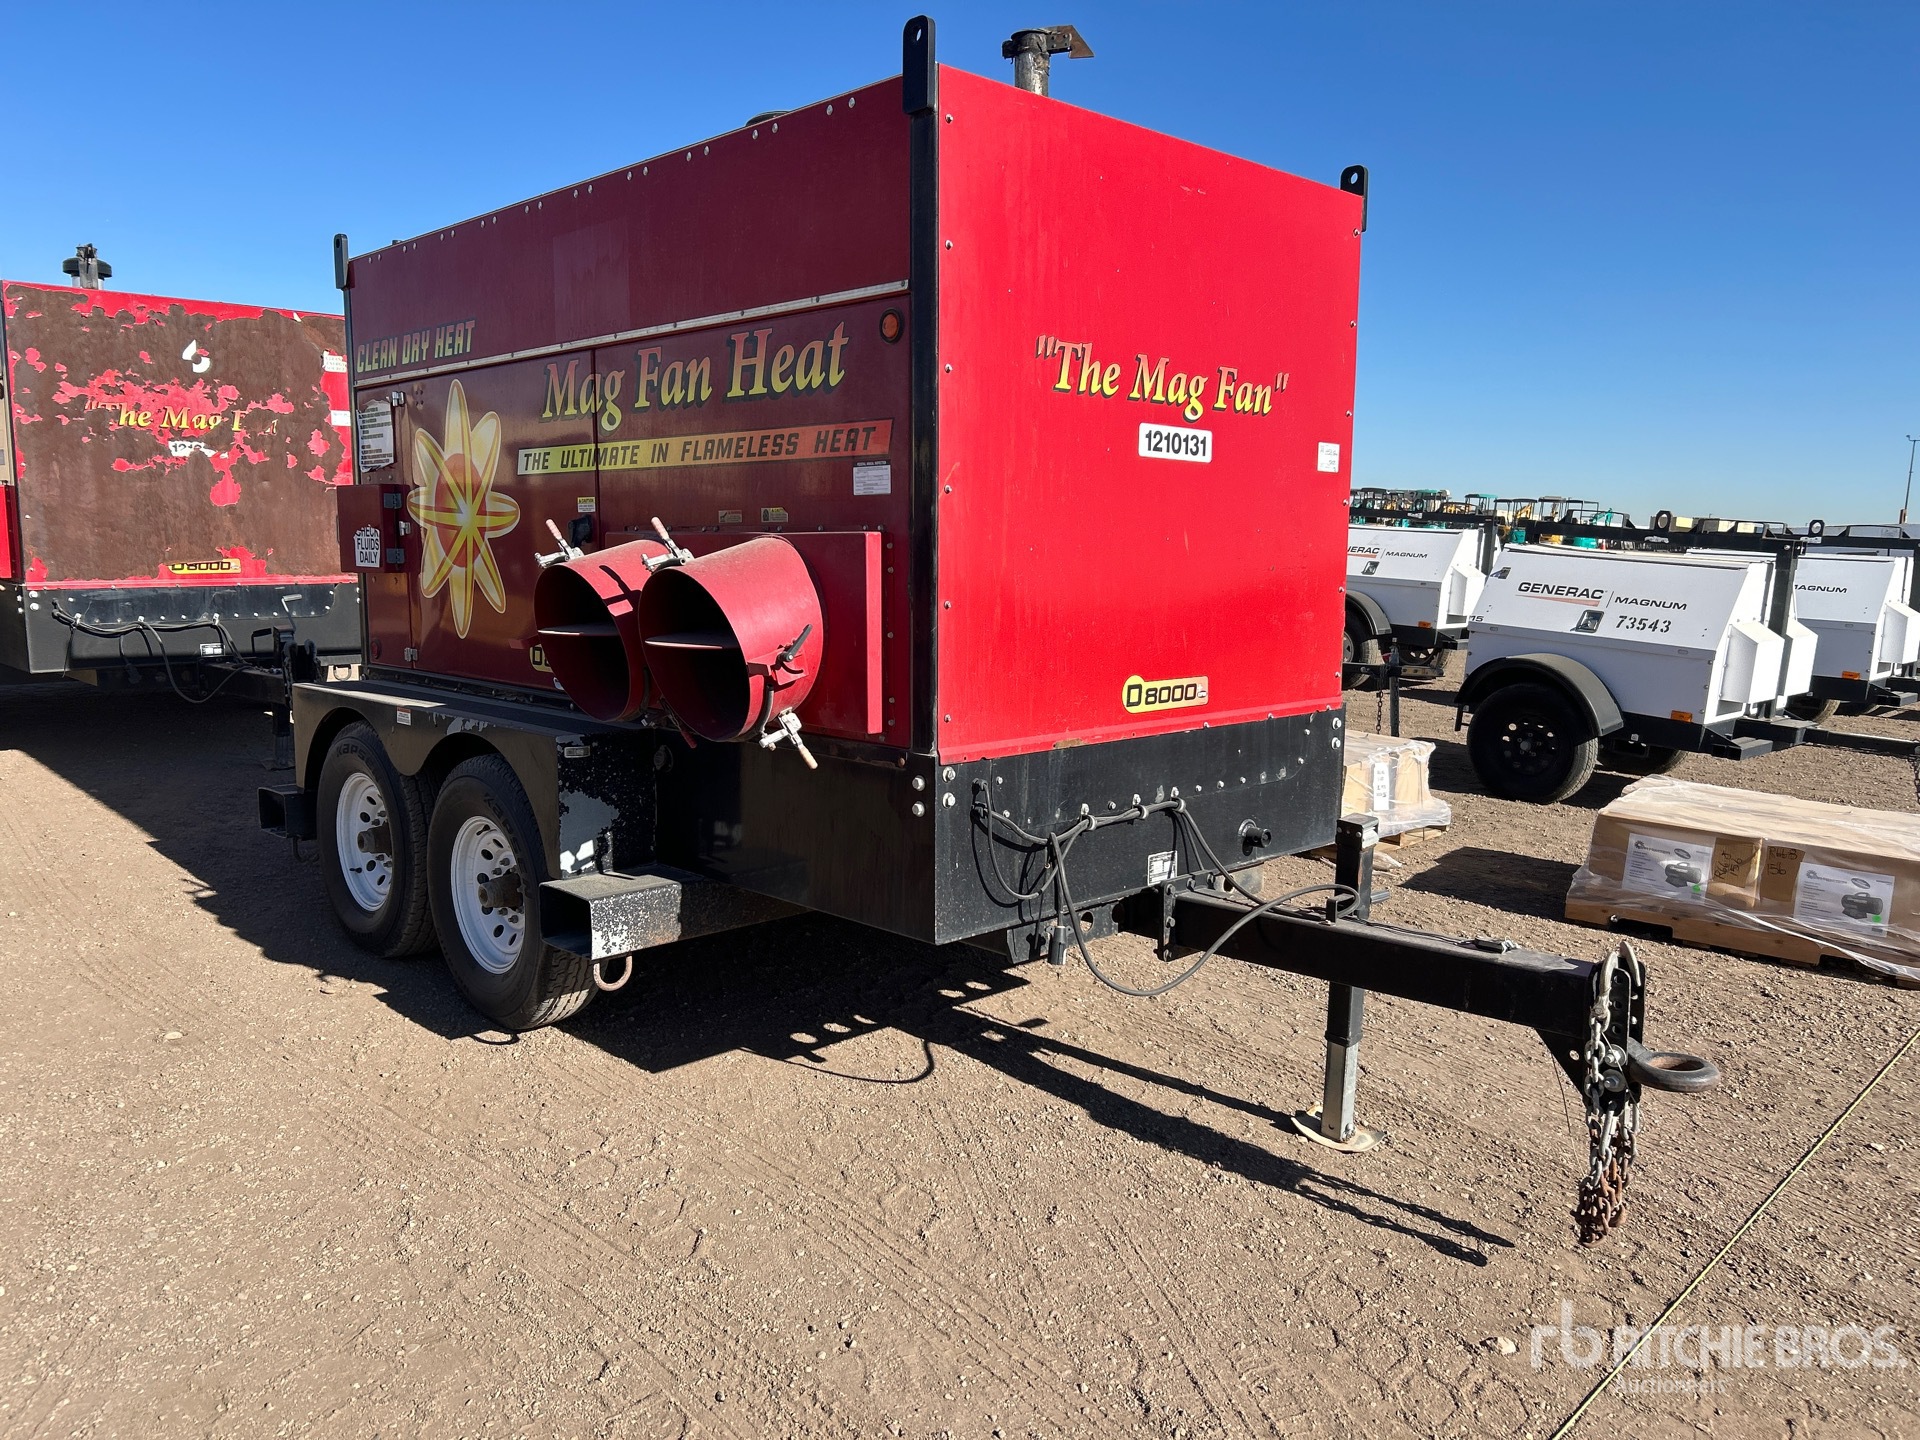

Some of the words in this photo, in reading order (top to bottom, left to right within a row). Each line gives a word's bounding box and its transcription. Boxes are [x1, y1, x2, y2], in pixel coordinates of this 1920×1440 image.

[356, 337, 398, 372] CLEAN
[402, 330, 430, 365] DRY
[434, 320, 476, 358] HEAT
[541, 358, 626, 433] Mag
[633, 346, 713, 409] Fan
[726, 321, 850, 400] Heat
[1036, 334, 1121, 397] "The
[1127, 353, 1209, 423] Mag
[1212, 366, 1290, 417] Fan"
[524, 452, 551, 471] THE
[560, 444, 640, 469] ULTIMATE
[651, 442, 670, 464] IN
[681, 432, 800, 461] FLAMELESS
[813, 426, 877, 454] HEAT
[1145, 429, 1207, 457] 1210131
[357, 538, 380, 551] FLUIDS
[360, 551, 378, 563] DAILY
[1385, 551, 1428, 559] MAGNUM
[1518, 581, 1604, 600] GENERAC
[1614, 596, 1687, 611] MAGNUM
[1615, 615, 1672, 633] 73543
